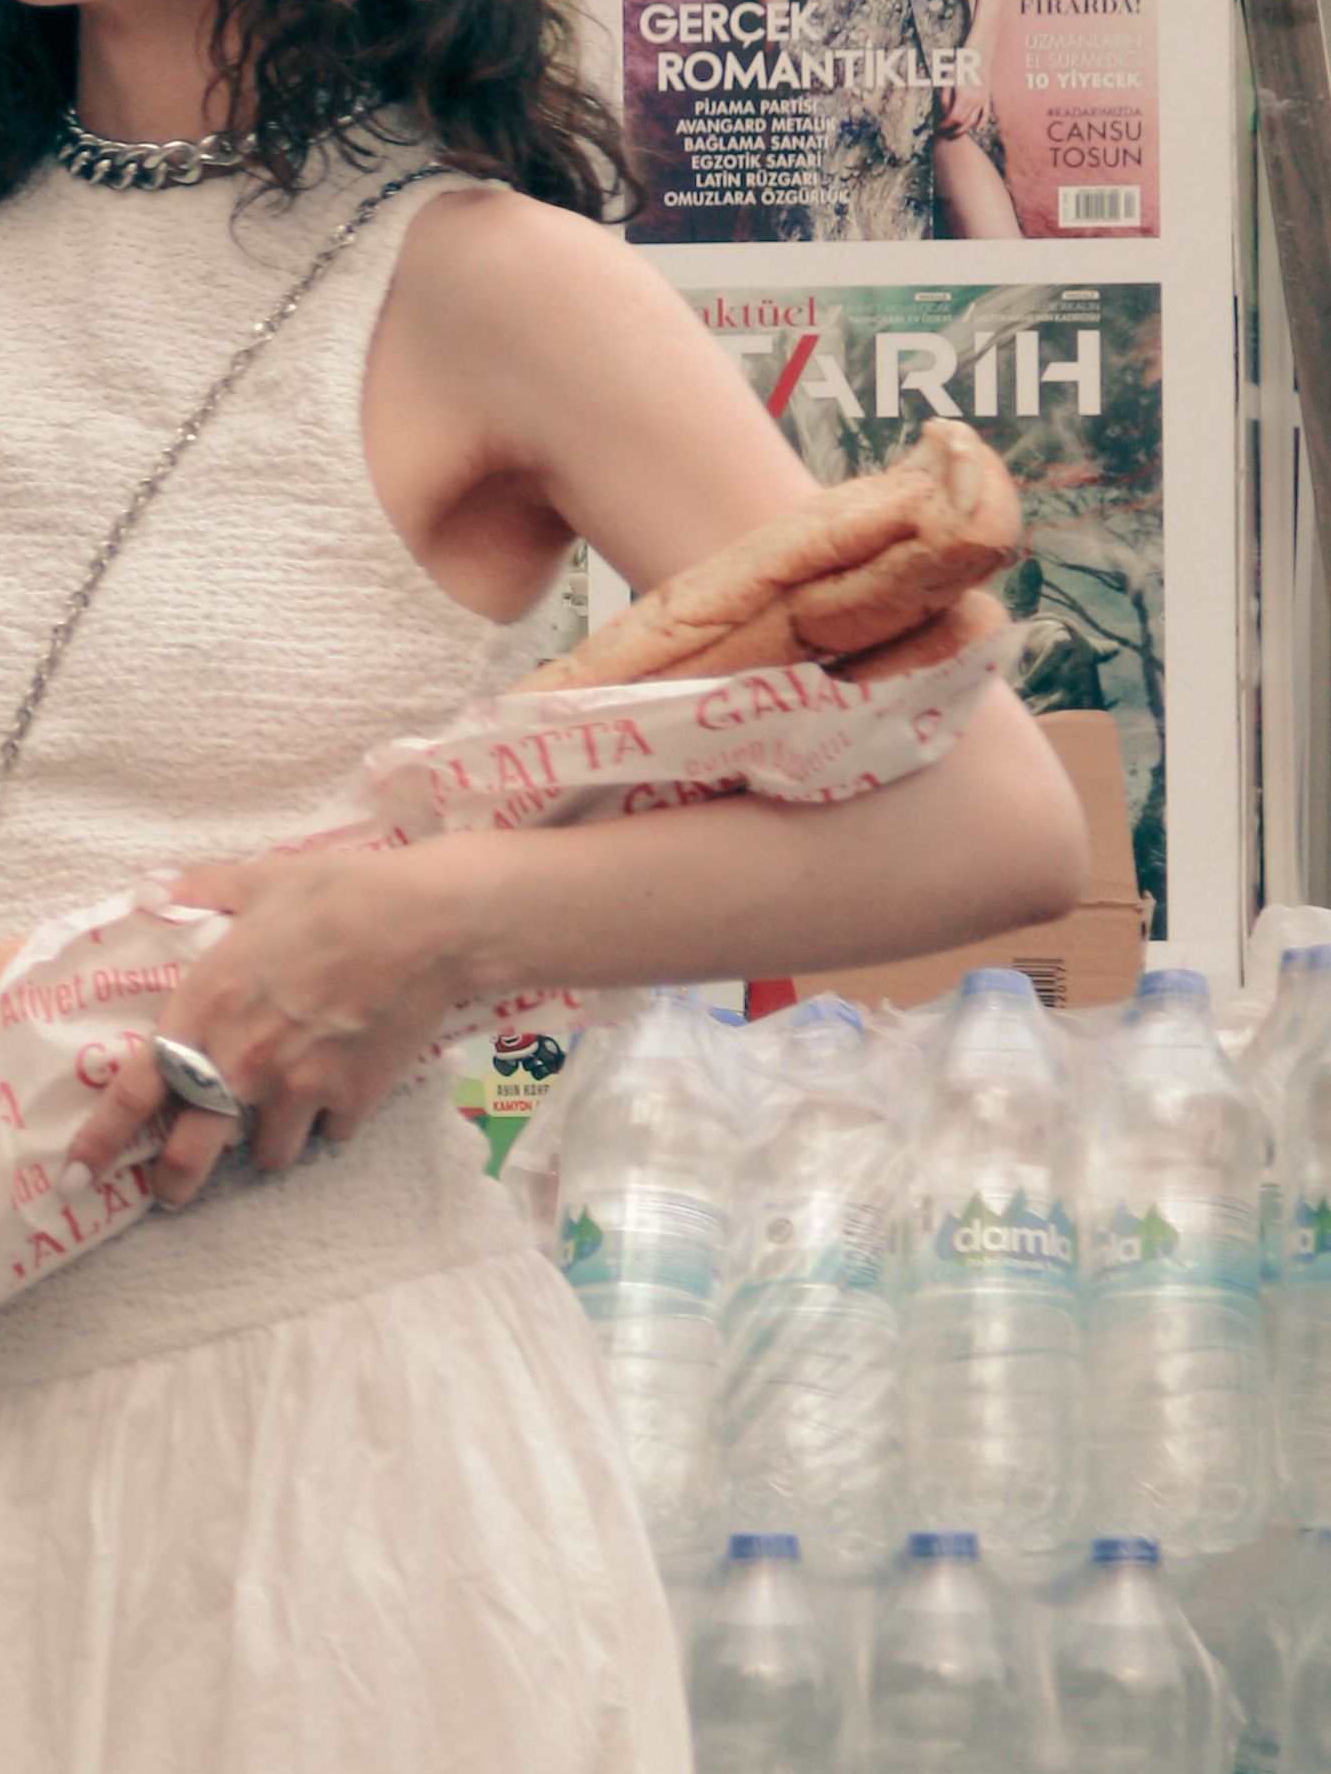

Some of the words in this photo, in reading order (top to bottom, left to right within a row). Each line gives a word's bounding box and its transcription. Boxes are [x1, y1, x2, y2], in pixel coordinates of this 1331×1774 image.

[639, 2, 821, 49] GERÇEK
[657, 42, 983, 92] ROMANTİKLER
[1026, 72, 1050, 90] 10
[1058, 68, 1141, 90] YİYECEK
[694, 97, 755, 115] PİJAMA
[676, 118, 767, 134] AVANGARD
[1046, 121, 1142, 142] CANSU
[684, 134, 766, 152] BAĞLAMA
[690, 152, 762, 169] EGZOTİK
[765, 152, 823, 169] SAFARİ
[1049, 147, 1142, 168] TOSUN
[695, 170, 742, 187] LATİN
[664, 190, 757, 207] OMUZLARA
[0, 974, 87, 1027] Afiyet
[93, 960, 184, 1004] Olsun
